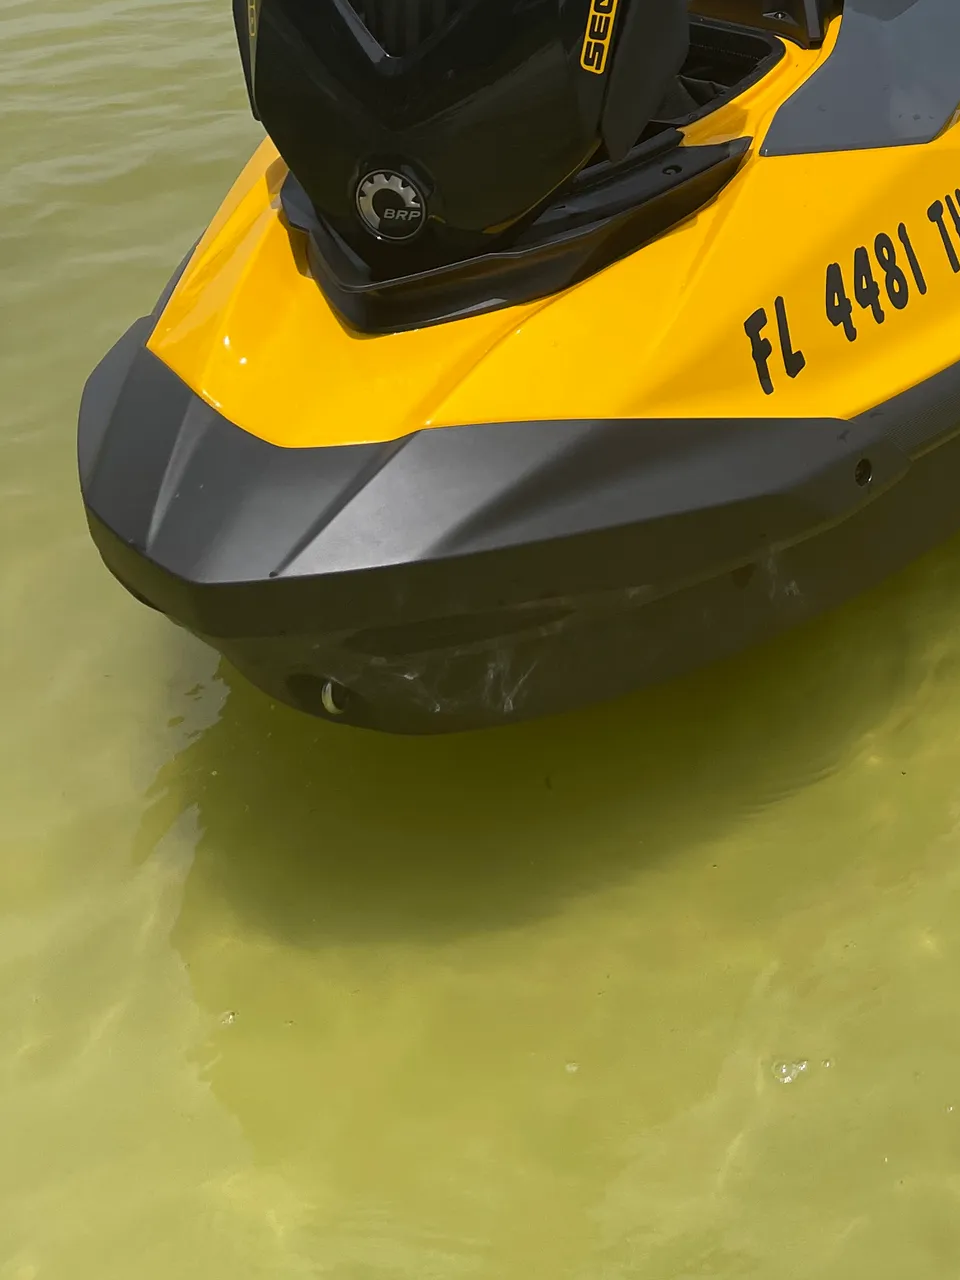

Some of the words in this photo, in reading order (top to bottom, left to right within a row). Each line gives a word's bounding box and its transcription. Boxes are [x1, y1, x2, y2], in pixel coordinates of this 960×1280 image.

[383, 208, 421, 221] BRP
[743, 295, 806, 395] FL
[825, 222, 927, 342] 4481
